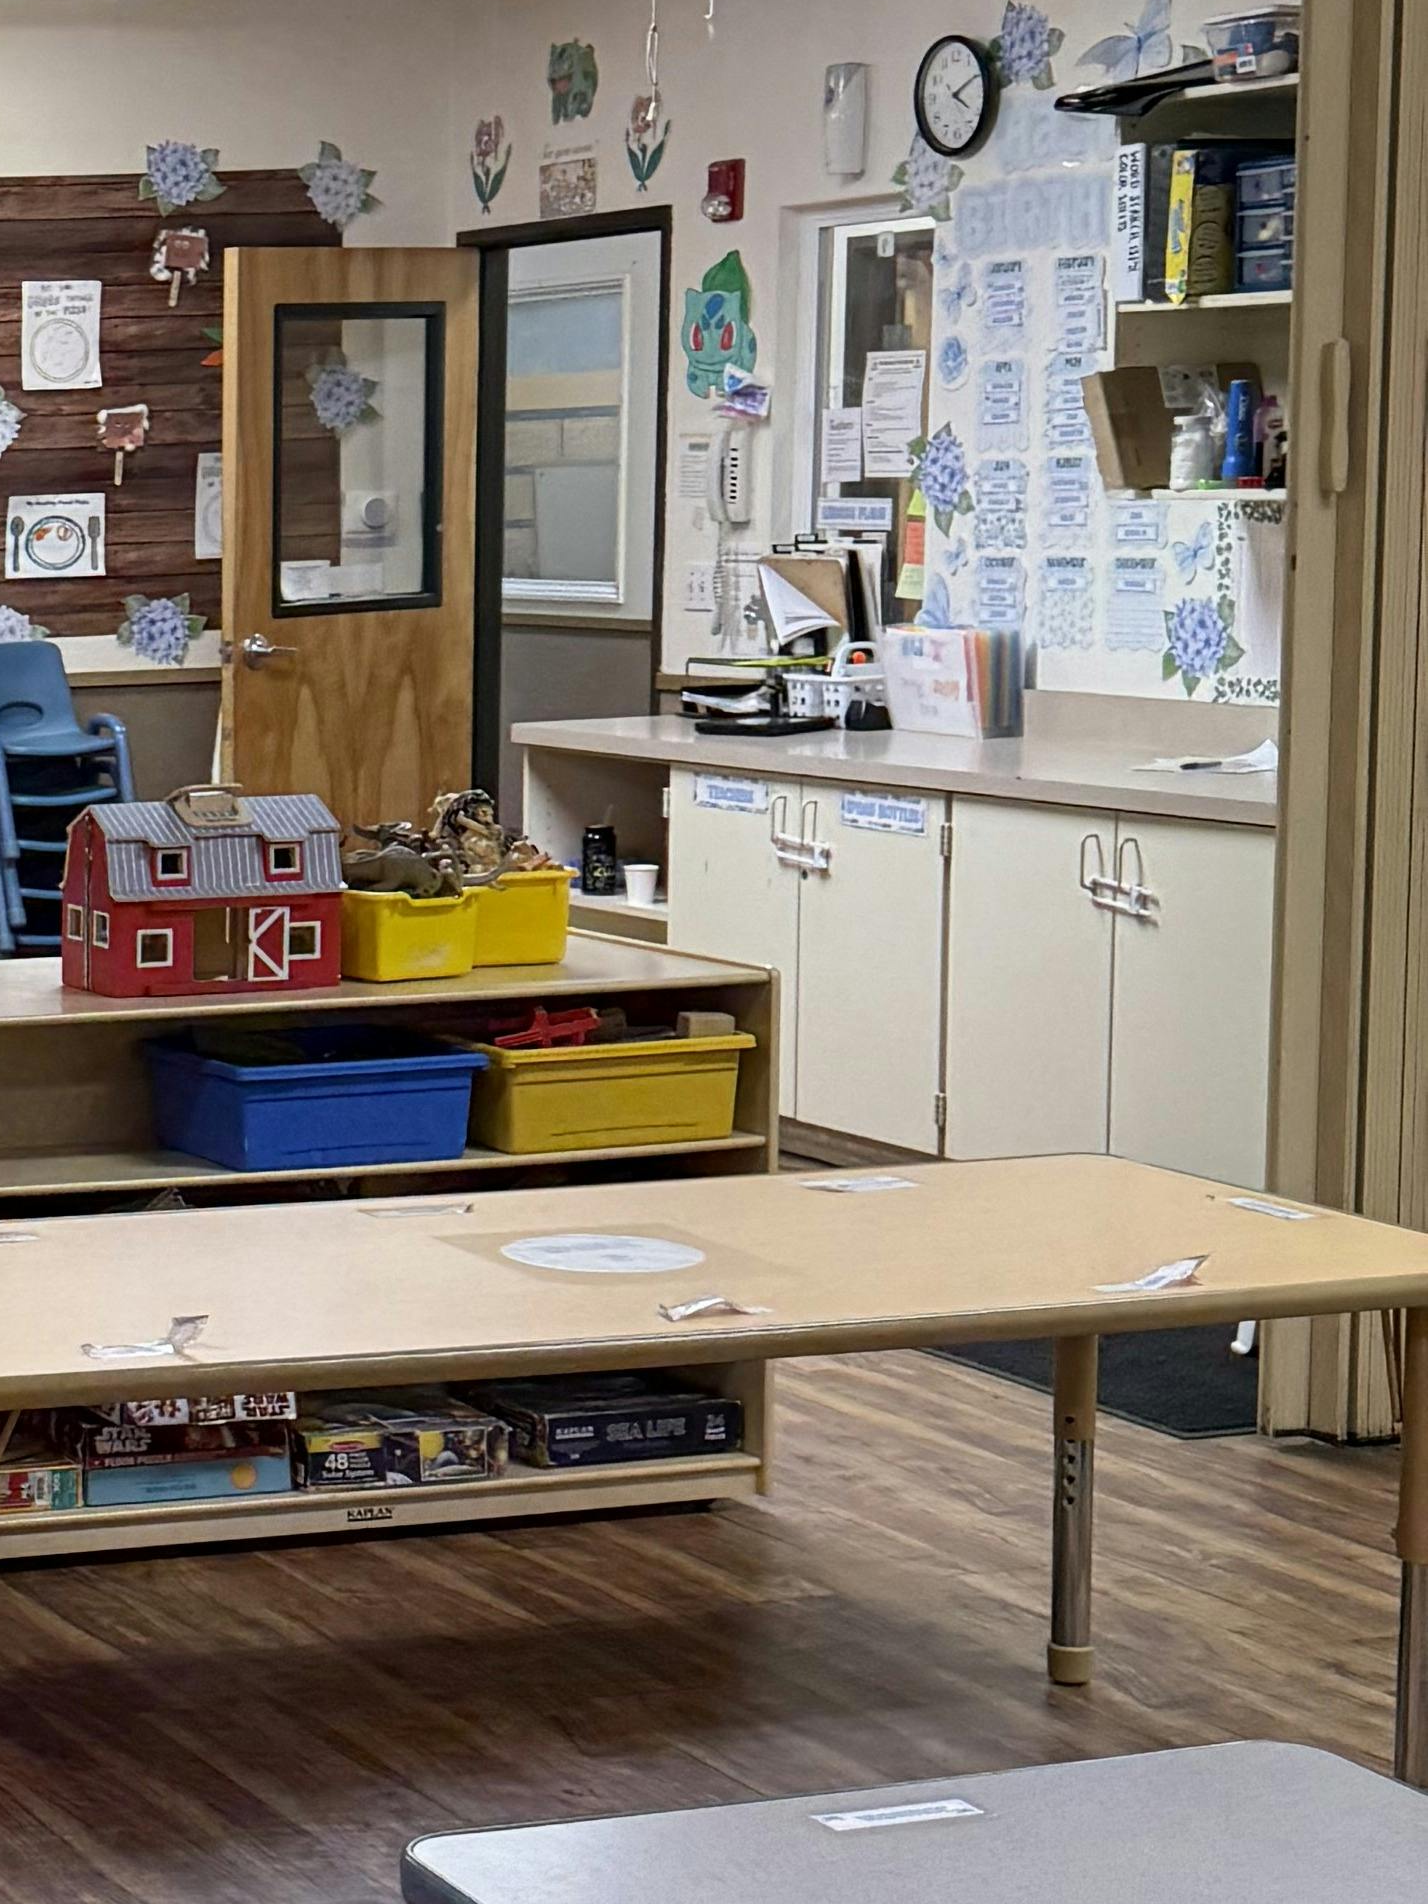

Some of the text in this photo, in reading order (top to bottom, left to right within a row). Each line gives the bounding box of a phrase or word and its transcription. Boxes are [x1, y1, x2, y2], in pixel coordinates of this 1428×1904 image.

[94, 1424, 152, 1441] STAR
[606, 1422, 643, 1442] SEA
[95, 1438, 152, 1454] WARS
[324, 1453, 349, 1470] 48
[347, 1507, 393, 1520] KAPLAN
